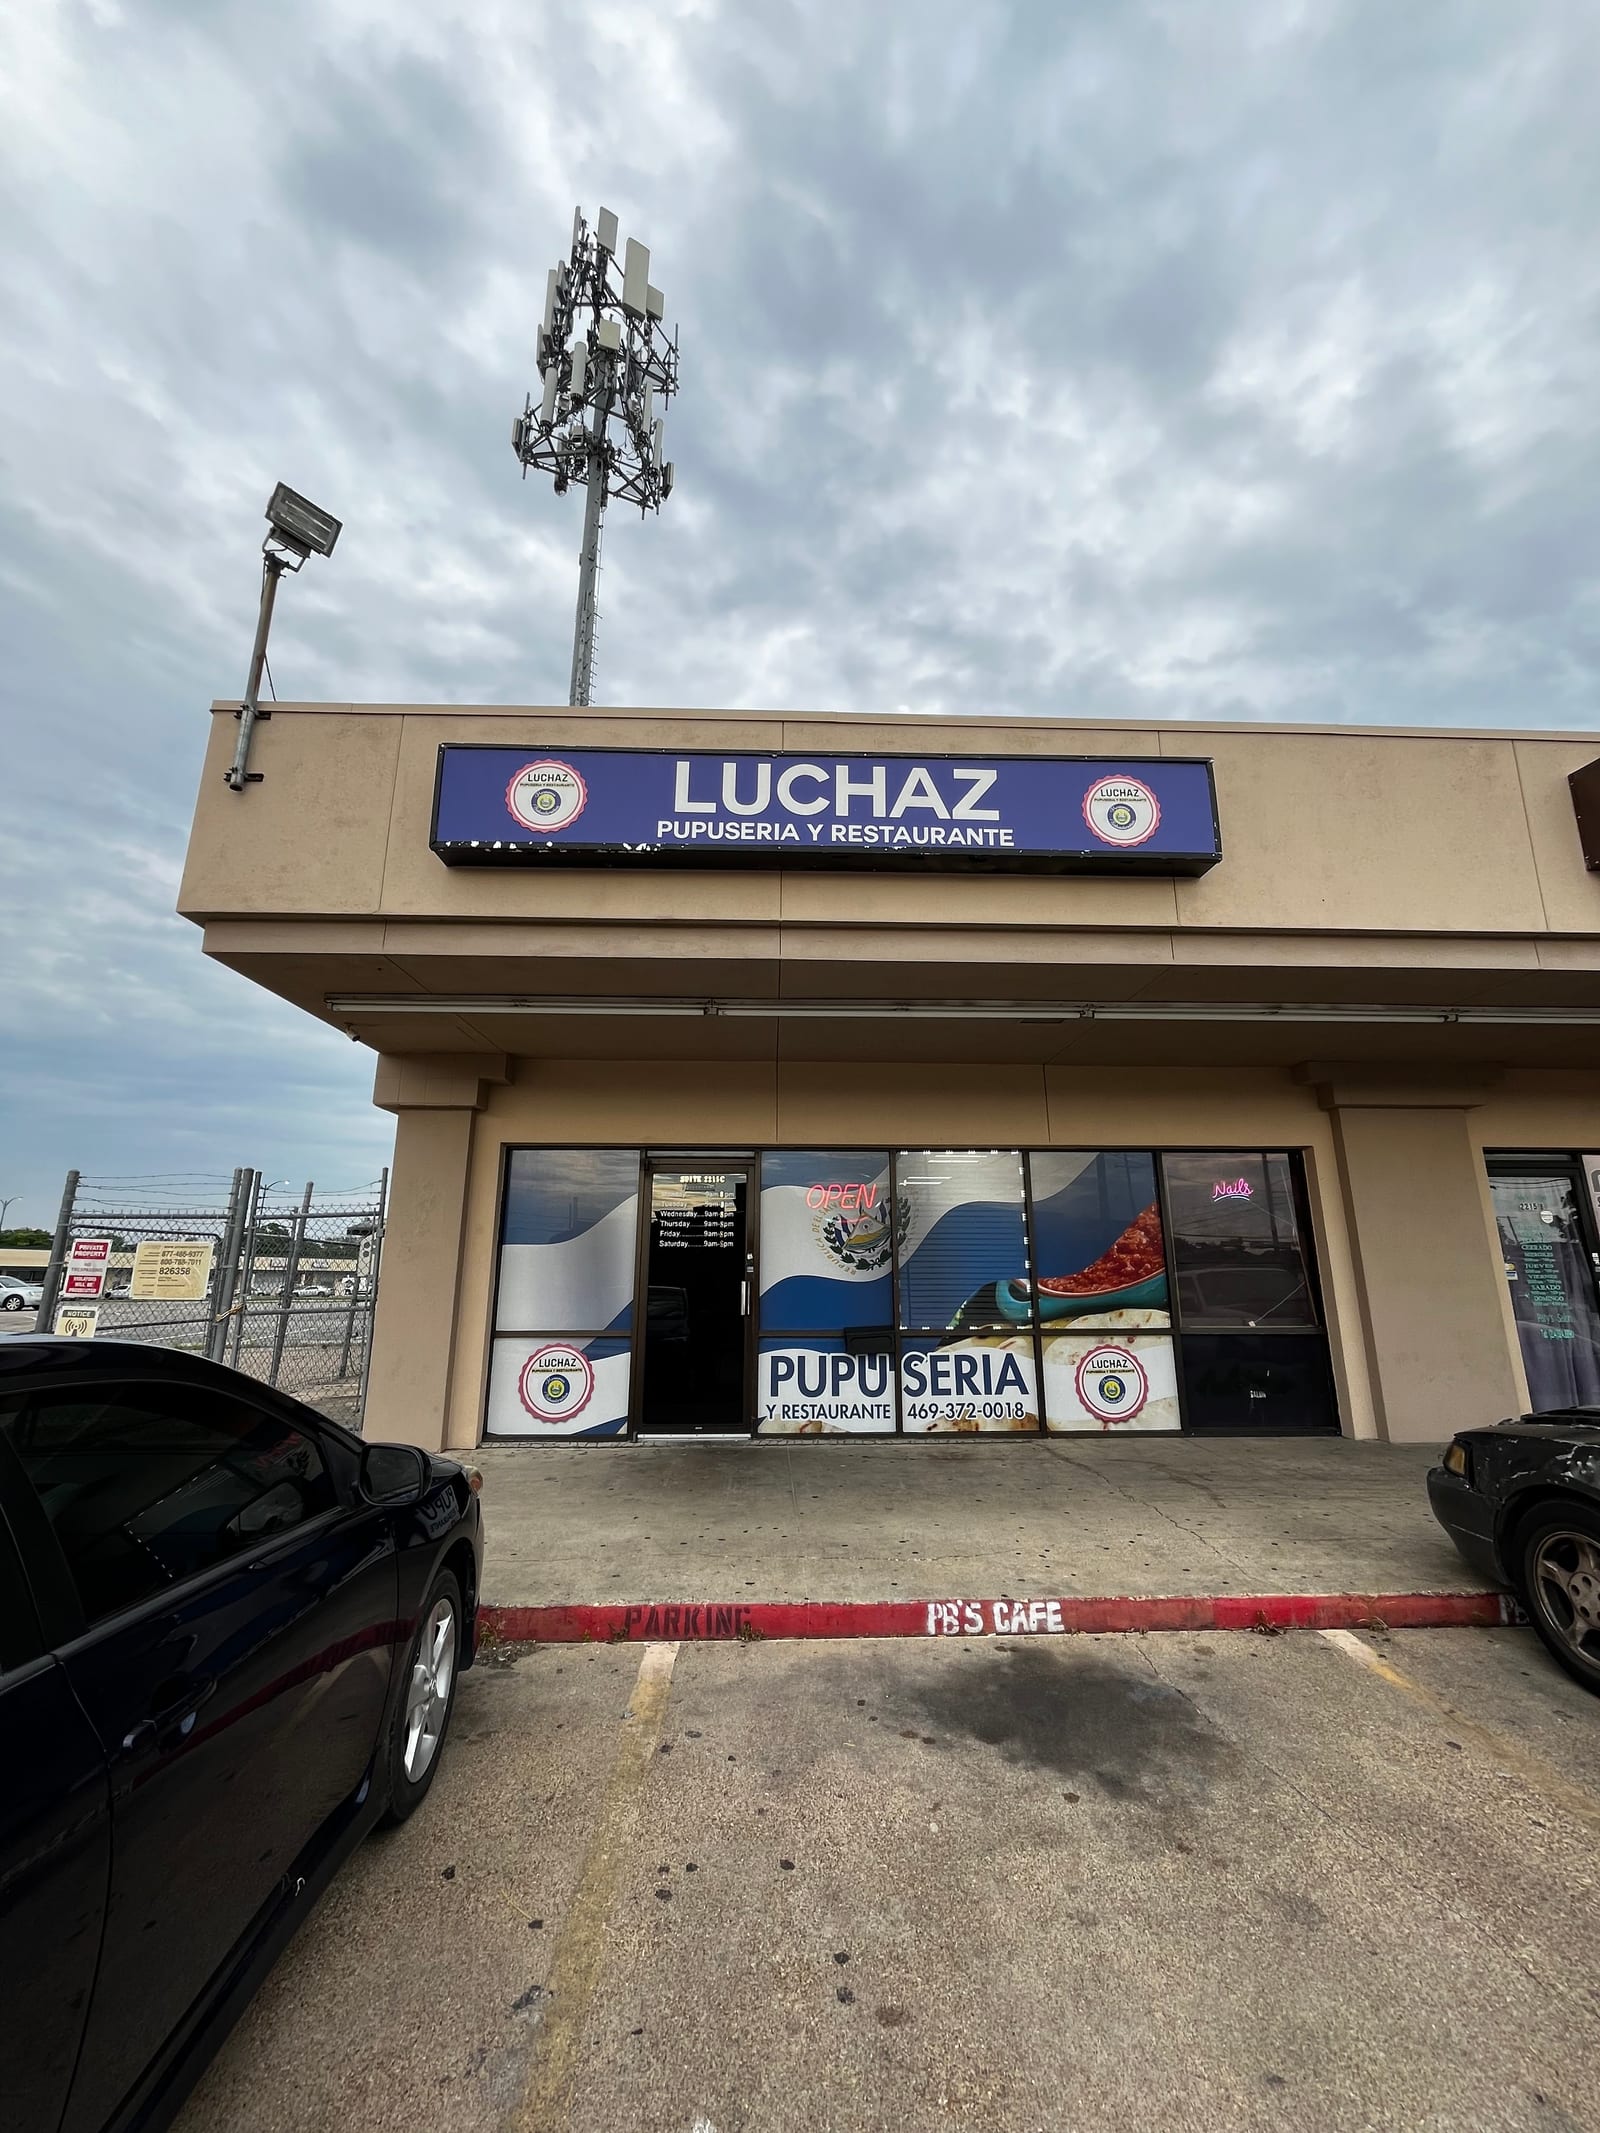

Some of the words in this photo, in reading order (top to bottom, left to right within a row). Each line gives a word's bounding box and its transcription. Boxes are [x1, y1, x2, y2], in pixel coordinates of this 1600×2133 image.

[528, 773, 569, 782] LUCHAZ
[674, 761, 1000, 821] LUCHAZ
[1100, 788, 1140, 797] LUCHAZ
[657, 820, 800, 841] PUPUSERIA
[807, 823, 824, 841] Y
[831, 824, 1015, 847] RESTAURANTE
[806, 1183, 877, 1209] OPEN
[1212, 1178, 1254, 1198] Nails
[660, 1230, 681, 1238] Friday
[659, 1240, 689, 1248] Saturday
[539, 1358, 577, 1368] LUCHAZ
[1091, 1359, 1128, 1369] LUCHAZ
[766, 1404, 777, 1419] Y
[782, 1404, 891, 1419] RESTAURANTE
[907, 1402, 1025, 1419] 469-372-0018
[624, 1605, 751, 1637] PARKING
[993, 1601, 1064, 1633] CAFE
